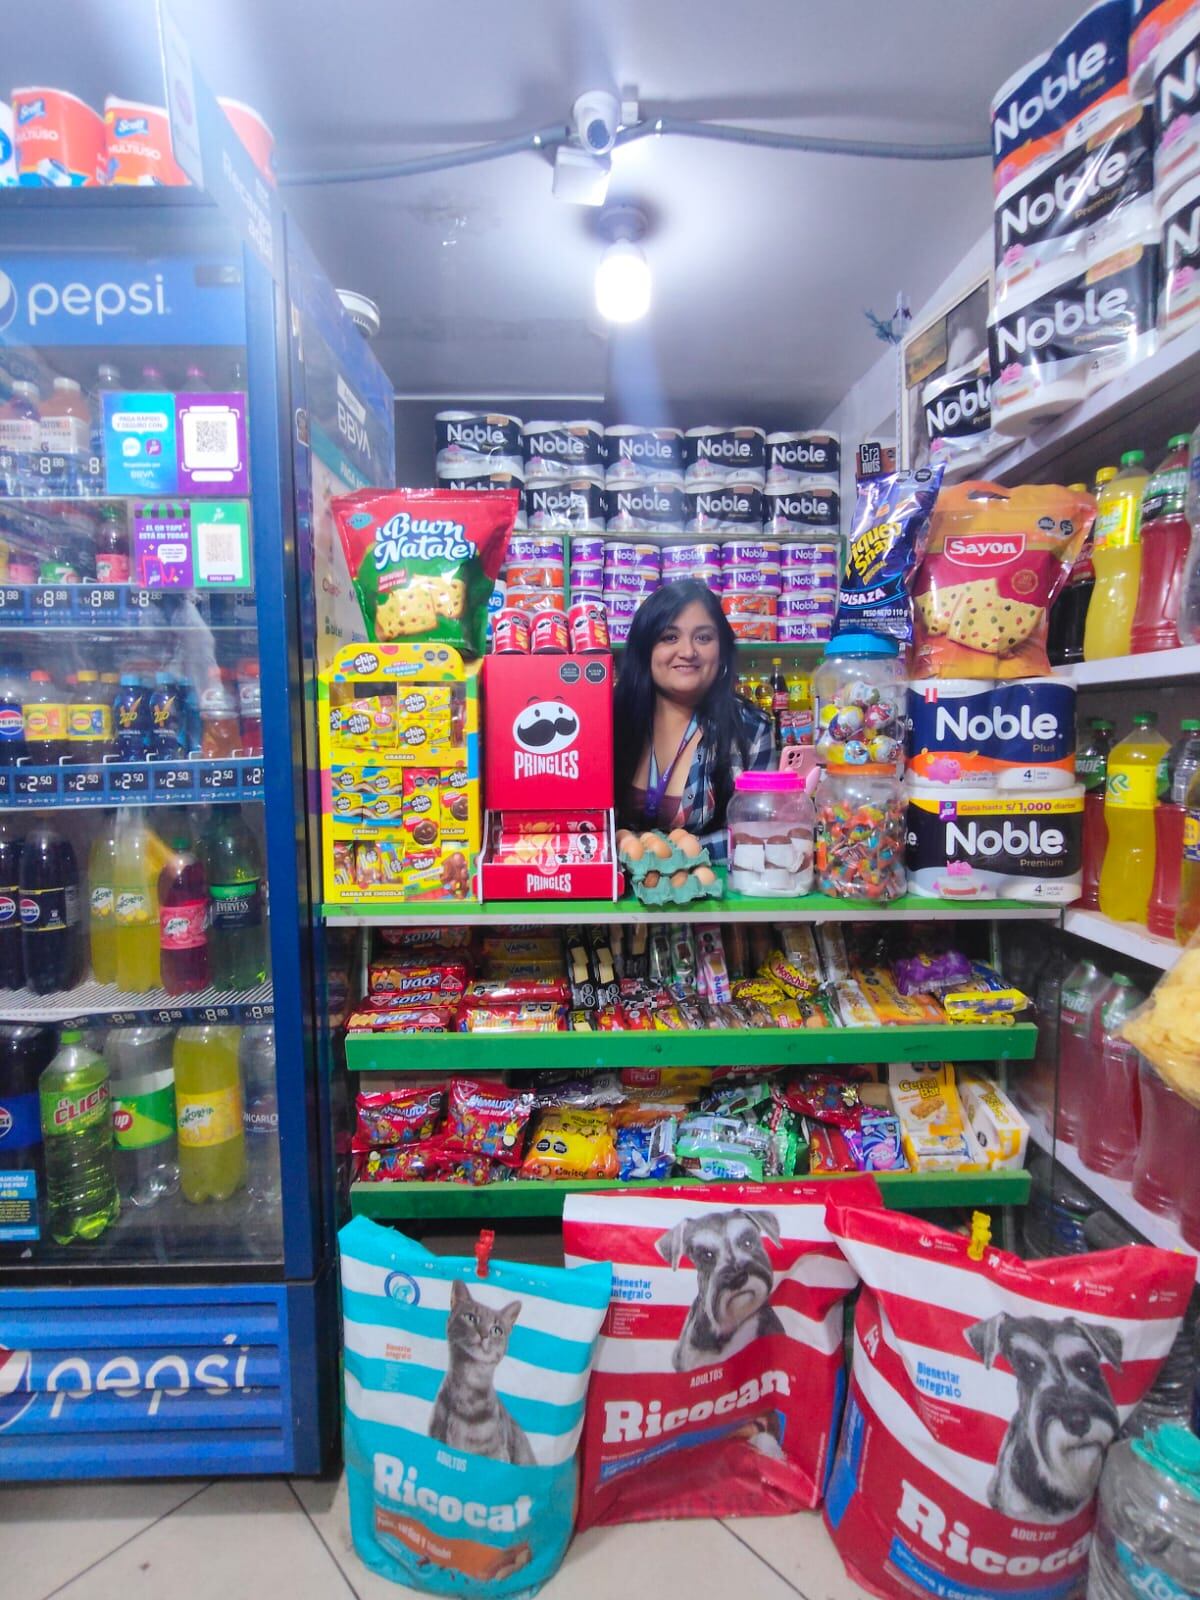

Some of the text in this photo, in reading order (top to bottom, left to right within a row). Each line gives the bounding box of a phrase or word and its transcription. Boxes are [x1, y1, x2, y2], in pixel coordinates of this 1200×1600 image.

[994, 41, 1110, 154] Noble
[1002, 150, 1128, 246] Noble
[28, 274, 165, 325] pepsi
[999, 286, 1129, 363] Noble
[337, 400, 371, 460] BBVA
[447, 423, 504, 444] Noble
[530, 437, 584, 455] Noble
[619, 438, 671, 458] Noble
[697, 439, 750, 458] Noble
[771, 445, 826, 464] Noble
[617, 494, 671, 511] Noble
[696, 495, 749, 513] Noble
[775, 498, 829, 515] Noble
[374, 536, 475, 570] Natale!
[511, 543, 541, 554] Noble
[741, 548, 769, 559] Noble
[795, 549, 822, 560] Noble
[950, 539, 1017, 557] Sayon
[738, 572, 766, 583] Noble
[792, 576, 819, 586] Noble
[792, 600, 819, 611] Noble
[936, 705, 1058, 742] Noble
[1032, 743, 1055, 753] Plus
[514, 750, 579, 780] PRINGLES
[1024, 769, 1032, 780] 4
[961, 804, 982, 812] Gana
[984, 803, 1003, 811] hasta
[1019, 802, 1052, 813] 1,000
[945, 820, 1064, 856] Noble
[1020, 859, 1064, 868] Premium
[526, 871, 571, 893] PRINGLES
[1034, 885, 1042, 894] 4
[899, 1079, 938, 1092] Cereal
[920, 1086, 941, 1099] Bar
[54, 1086, 109, 1126] CLICK
[47, 1333, 250, 1419] pepsi
[690, 1368, 723, 1388] ADULTOS
[917, 1361, 960, 1385] Bienestar
[602, 1370, 791, 1444] Ricocan
[374, 1452, 533, 1533] Ricocat
[897, 1479, 1093, 1576] Ricoca
[1010, 1527, 1057, 1542] ADULTOS
